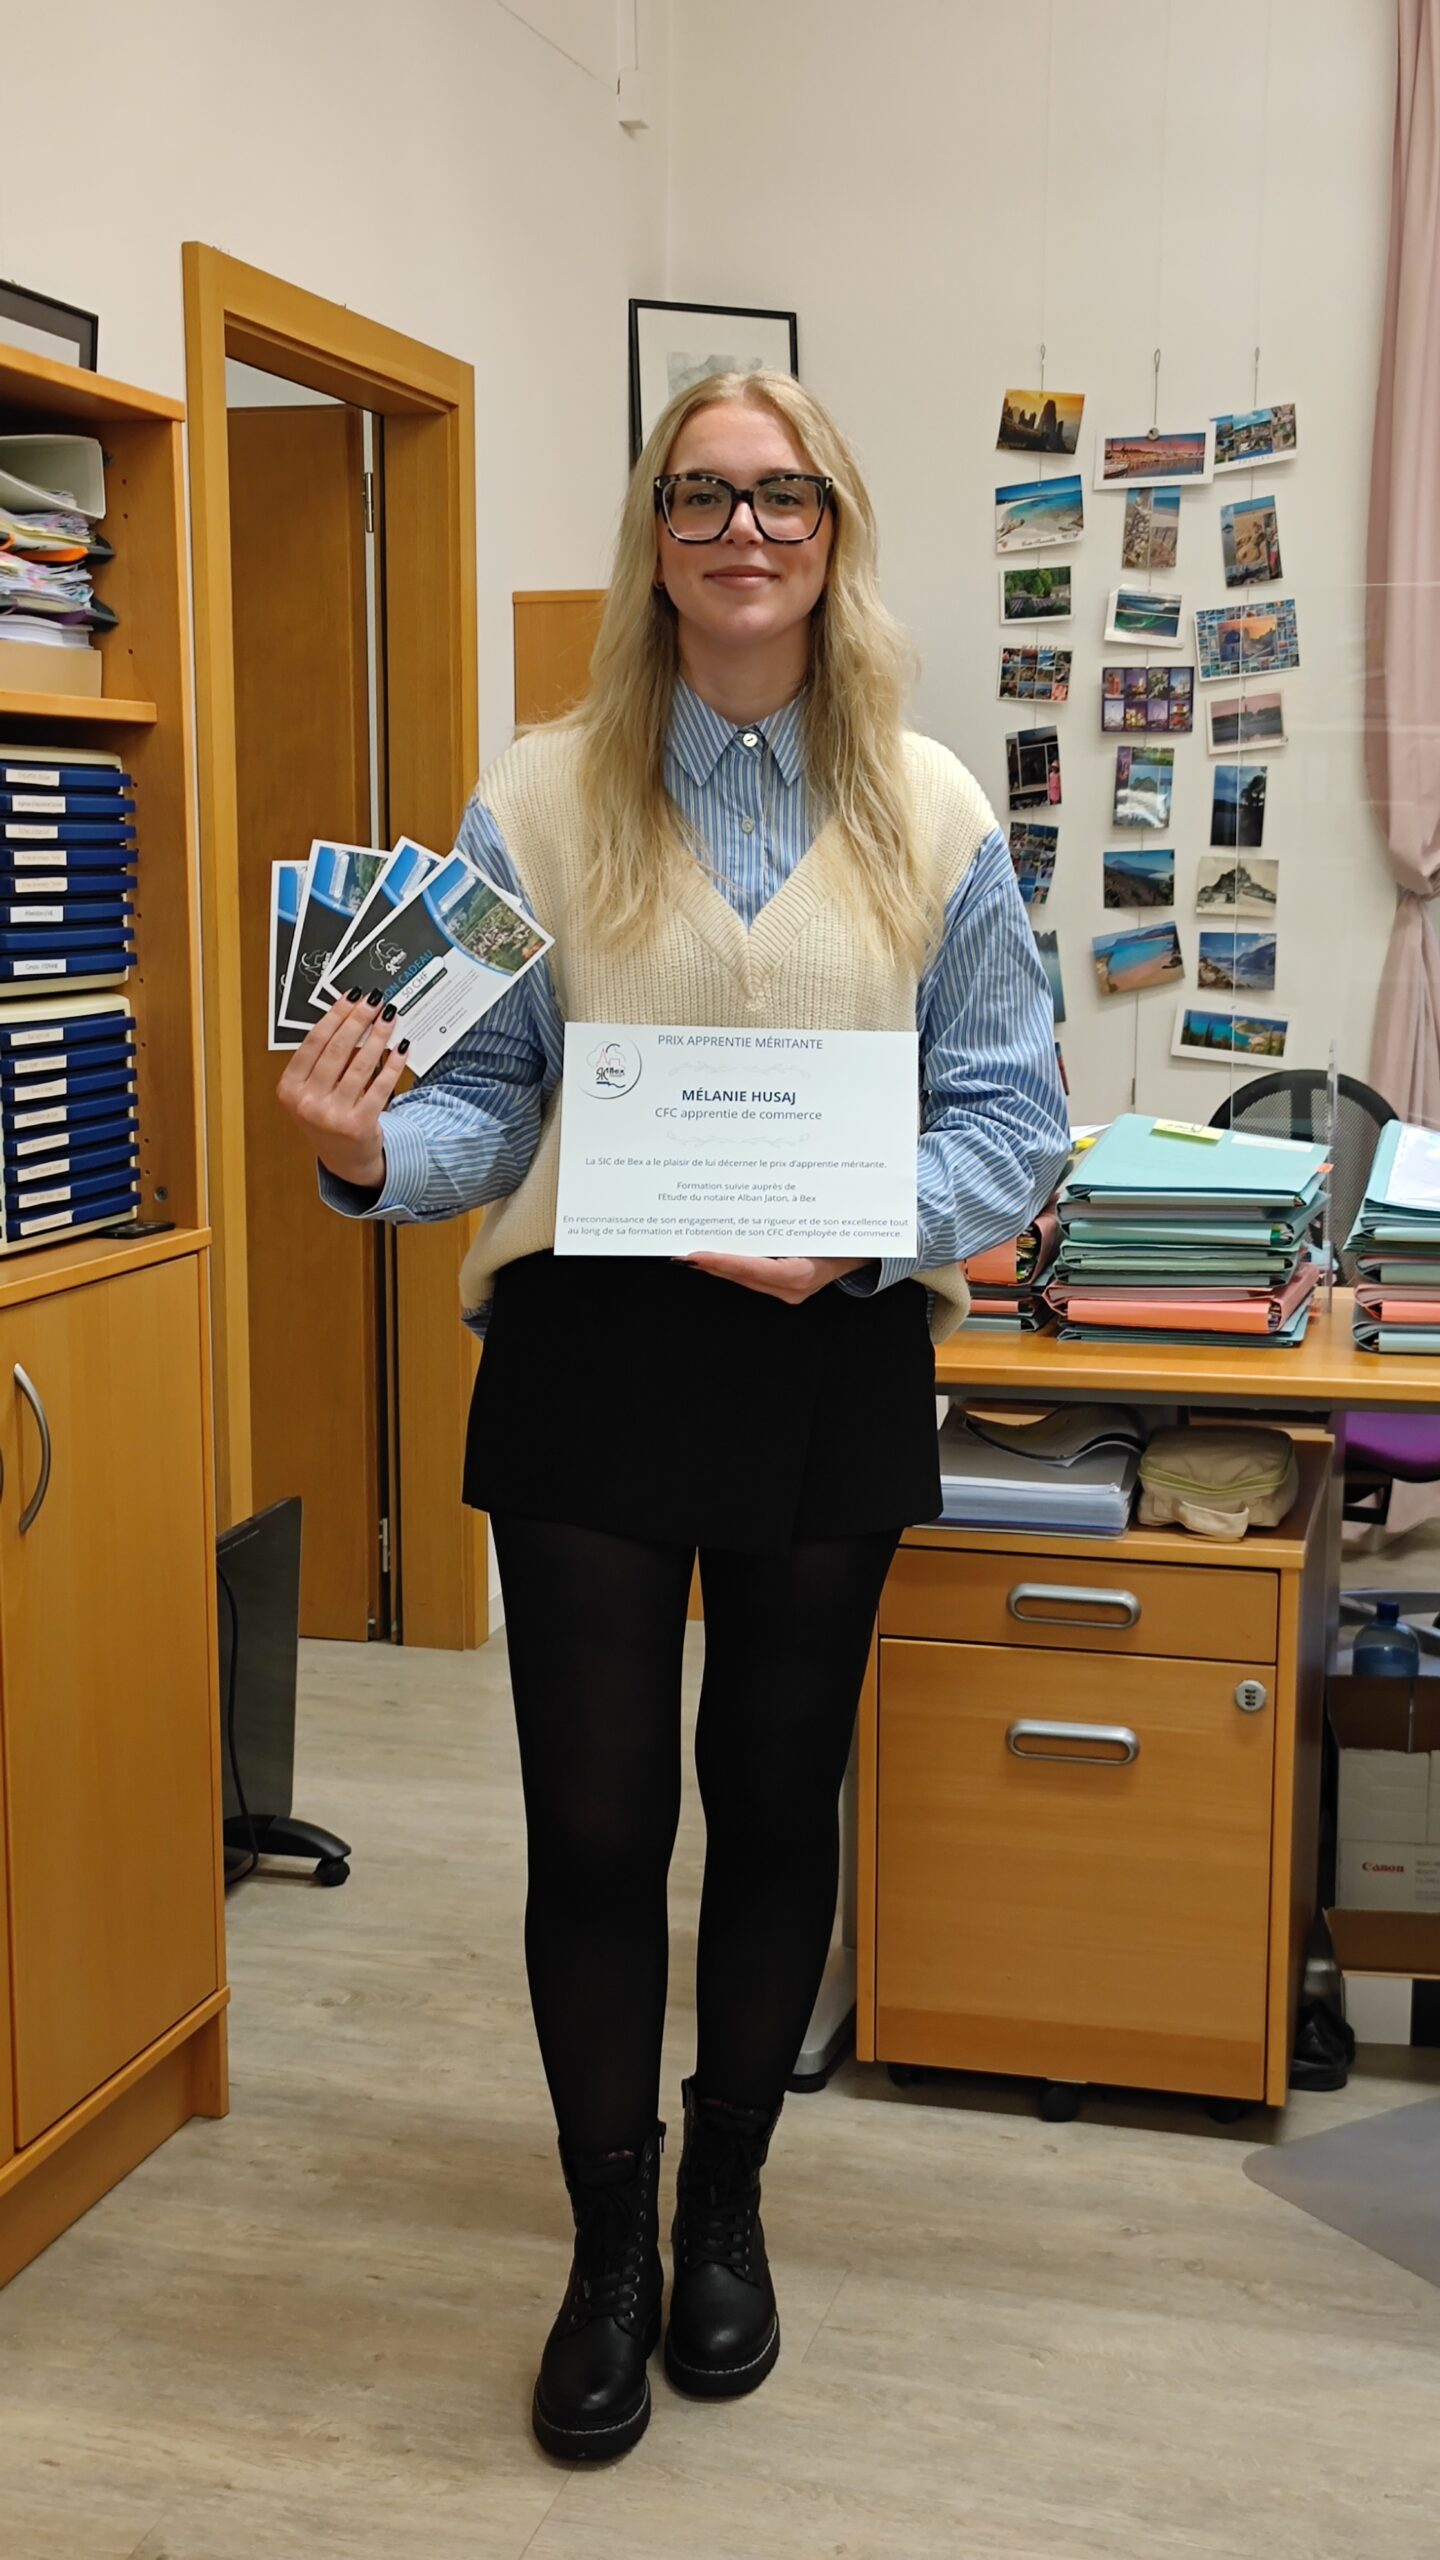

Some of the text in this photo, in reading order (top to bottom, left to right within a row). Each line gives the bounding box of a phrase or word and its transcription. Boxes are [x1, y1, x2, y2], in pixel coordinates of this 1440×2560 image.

[398, 948, 433, 983] CADEAU
[402, 986, 414, 999] 50
[412, 971, 428, 988] CHF
[658, 1035, 823, 1049] PRIX APPRENTIE MÉRITANTE
[682, 1087, 796, 1104] MÉLANIE HUSAJ
[655, 1106, 822, 1121] CFC apprentie de commerce
[586, 1157, 596, 1166] La
[598, 1157, 612, 1166] SIC
[614, 1157, 625, 1166] de
[627, 1157, 643, 1166] Bex
[653, 1157, 661, 1166] le
[663, 1158, 689, 1168] plaisir
[692, 1158, 703, 1167] de
[705, 1158, 716, 1167] lui
[718, 1159, 757, 1168] décerner
[760, 1159, 767, 1168] le
[770, 1160, 786, 1169] prix
[789, 1159, 839, 1170] d'apprentie
[841, 1160, 886, 1169] méritante.
[677, 1181, 796, 1192] Formation suivie auprès de
[658, 1192, 687, 1201] l'Etude
[690, 1193, 701, 1202] du
[704, 1194, 735, 1202] notaire
[737, 1193, 762, 1202] Alban
[764, 1194, 789, 1204] Jaton,
[800, 1194, 816, 1203] Bex
[563, 1215, 574, 1223] En
[576, 1216, 644, 1224] reconnaissance
[647, 1215, 658, 1225] de
[660, 1217, 676, 1225] son
[679, 1217, 735, 1227] engagement,
[738, 1217, 749, 1225] de
[764, 1217, 796, 1227] rigueur
[798, 1218, 807, 1226] et
[809, 1217, 821, 1226] de
[823, 1218, 839, 1226] son
[842, 1217, 887, 1226] excellence
[890, 1218, 908, 1227] tout
[581, 1226, 600, 1237] long
[602, 1227, 614, 1235] de
[628, 1227, 672, 1236] formation
[674, 1228, 683, 1236] et
[685, 1227, 732, 1236] l'obtention
[735, 1228, 746, 1237] de
[748, 1229, 764, 1237] son
[767, 1228, 783, 1237] CFC
[786, 1228, 837, 1239] d'employée
[839, 1229, 850, 1237] de
[853, 1230, 902, 1238] commerce.
[1361, 1862, 1404, 1873] Canon
